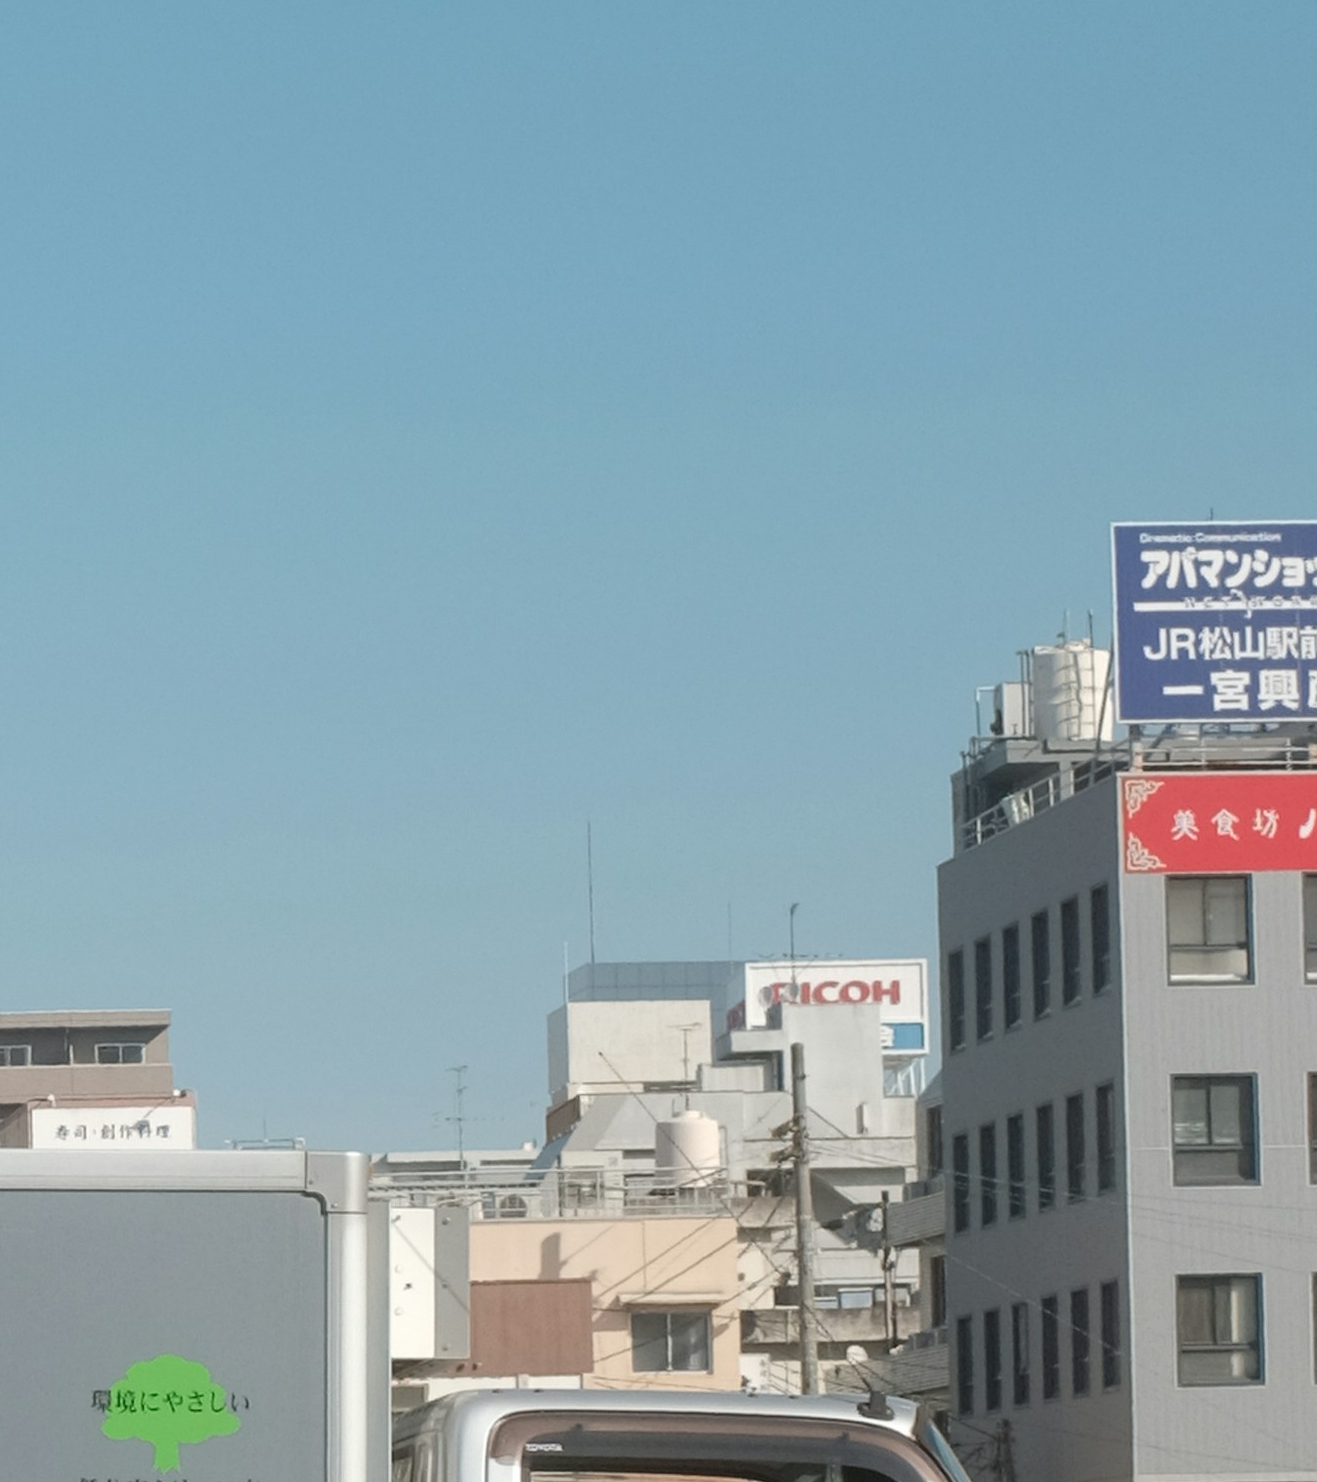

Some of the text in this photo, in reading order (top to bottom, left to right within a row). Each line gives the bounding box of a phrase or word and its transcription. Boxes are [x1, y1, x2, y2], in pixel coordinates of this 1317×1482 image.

[1162, 670, 1317, 711] 一宮興
[91, 1389, 250, 1414] 環境にやさしい
